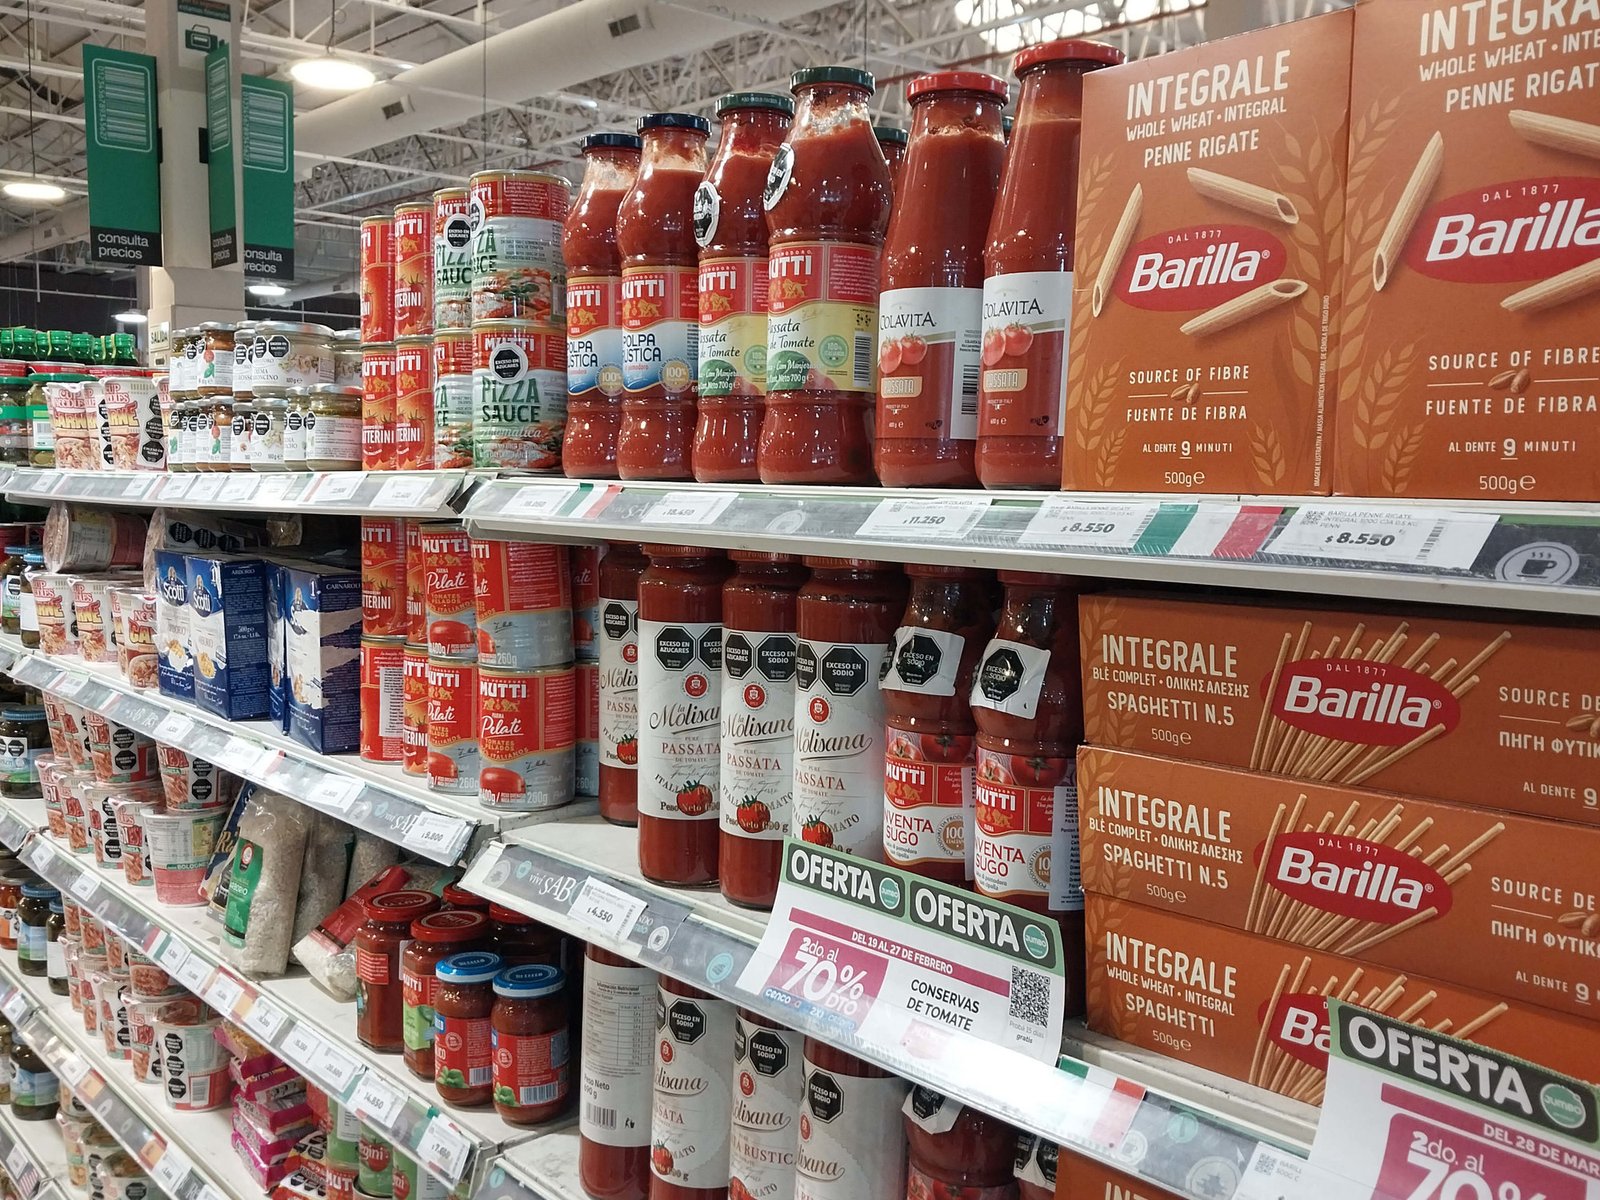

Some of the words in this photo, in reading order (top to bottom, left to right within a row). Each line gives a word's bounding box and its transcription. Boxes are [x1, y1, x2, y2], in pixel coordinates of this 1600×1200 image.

[1419, 53, 1476, 82] WHOLE
[1485, 38, 1547, 69] WHEAT
[1127, 50, 1291, 120] INTEGRALE
[1446, 77, 1515, 113] PENNE
[1127, 119, 1166, 141] WHOLE
[1171, 110, 1214, 133] WHEAT
[1225, 97, 1287, 122] INTEGRAL
[1144, 141, 1192, 169] PENNE
[1199, 129, 1259, 158] RIGATE
[1482, 189, 1512, 203] DAL
[1522, 184, 1559, 196] 1877
[97, 232, 149, 248] consulta
[1168, 234, 1189, 244] DAL
[1195, 230, 1222, 240] 1877
[98, 245, 143, 260] precios
[984, 298, 1043, 319] COLAVITA
[880, 311, 936, 330] COLAVITA
[779, 334, 815, 348] Tomate
[707, 345, 740, 358] Tomate
[1428, 352, 1499, 371] SOURCE
[1510, 350, 1532, 367] OF
[1544, 346, 1600, 366] FIBRE
[1129, 369, 1178, 384] SOURCE
[1186, 368, 1202, 381] OF
[1210, 365, 1249, 380] FIBRE
[481, 376, 540, 403] PIZZA
[482, 405, 541, 422] SAUCE
[1126, 408, 1174, 422] FUENTE
[1181, 407, 1197, 421] DE
[1205, 406, 1247, 420] FIBRA
[1425, 398, 1493, 416] FUENTE
[1504, 397, 1526, 414] DE
[1538, 395, 1598, 413] FIBRA
[1142, 443, 1152, 453] AL
[1154, 443, 1177, 453] DENTE
[1181, 441, 1191, 456] 9
[1195, 443, 1233, 453] MINUTI
[1448, 441, 1461, 453] AL
[1465, 441, 1496, 453] DENTE
[1503, 438, 1516, 457] 9
[1524, 440, 1576, 452] MINUTI
[1069, 522, 1116, 534] 8.550
[422, 539, 469, 553] MUTTI
[1336, 532, 1396, 547] 8.550
[427, 571, 466, 594] Pelati
[826, 661, 851, 670] EXCESO
[1102, 634, 1237, 678] INTEGRALE
[832, 669, 855, 677] SODIO
[1112, 669, 1157, 687] COMPLET
[1326, 663, 1350, 673] DAL
[1357, 665, 1387, 677] 1877
[480, 681, 527, 699] MUTTI
[1499, 686, 1570, 709] SOURCE
[1107, 691, 1198, 721] SPAGHETTI
[1205, 703, 1234, 726] N.5
[481, 716, 522, 738] Pelati
[661, 742, 720, 755] PASSATA
[727, 752, 782, 771] PASSATA
[795, 768, 846, 791] PASSATA
[886, 762, 925, 785] MUTTI
[1523, 781, 1537, 793] AL
[1541, 784, 1576, 799] DENTE
[1099, 786, 1231, 843] INTEGRALE
[886, 827, 919, 846] SUGO
[1108, 823, 1151, 844] COMPLET
[1319, 838, 1342, 849] DAL
[1349, 842, 1378, 857] 1877
[976, 854, 1008, 877] SUGO
[1103, 843, 1192, 881] SPAGHETTI
[1200, 865, 1228, 889] N.5
[791, 850, 876, 904] OFERTA
[1491, 876, 1562, 904] SOURCE
[1574, 891, 1595, 911] DE
[915, 888, 1019, 952] OFERTA
[827, 948, 839, 963] al
[852, 931, 867, 945] DEL
[867, 936, 878, 948] 19
[879, 940, 889, 953] AL
[890, 944, 901, 955] 27
[901, 947, 914, 961] DE
[914, 952, 953, 974] FEBRERO
[1107, 931, 1237, 998] INTEGRALE
[1107, 964, 1138, 986] WHOLE
[1141, 976, 1175, 997] WHEAT
[1185, 990, 1235, 1016] INTEGRAL
[1516, 970, 1529, 983] AL
[1533, 974, 1568, 992] DENTE
[824, 992, 857, 1015] DTO
[911, 979, 980, 1014] CONSERVAS
[672, 1012, 690, 1022] EXCESO
[676, 1019, 694, 1028] SODIO
[907, 997, 922, 1013] DE
[925, 1002, 973, 1031] TOMATE
[1126, 993, 1214, 1037] SPAGHETTI
[752, 1042, 772, 1053] EXCESO
[773, 1045, 783, 1054] EN
[1016, 1033, 1033, 1045] gratis
[757, 1050, 776, 1060] SODIO
[1349, 1016, 1533, 1115] OFERTA
[595, 1081, 610, 1091] Neto
[810, 1083, 828, 1098] EXCESO
[813, 1093, 831, 1104] SODIO
[1483, 1123, 1513, 1146] DEL
[1515, 1136, 1535, 1153] 28
[1538, 1144, 1560, 1162] DE
[1465, 1154, 1485, 1175] al
